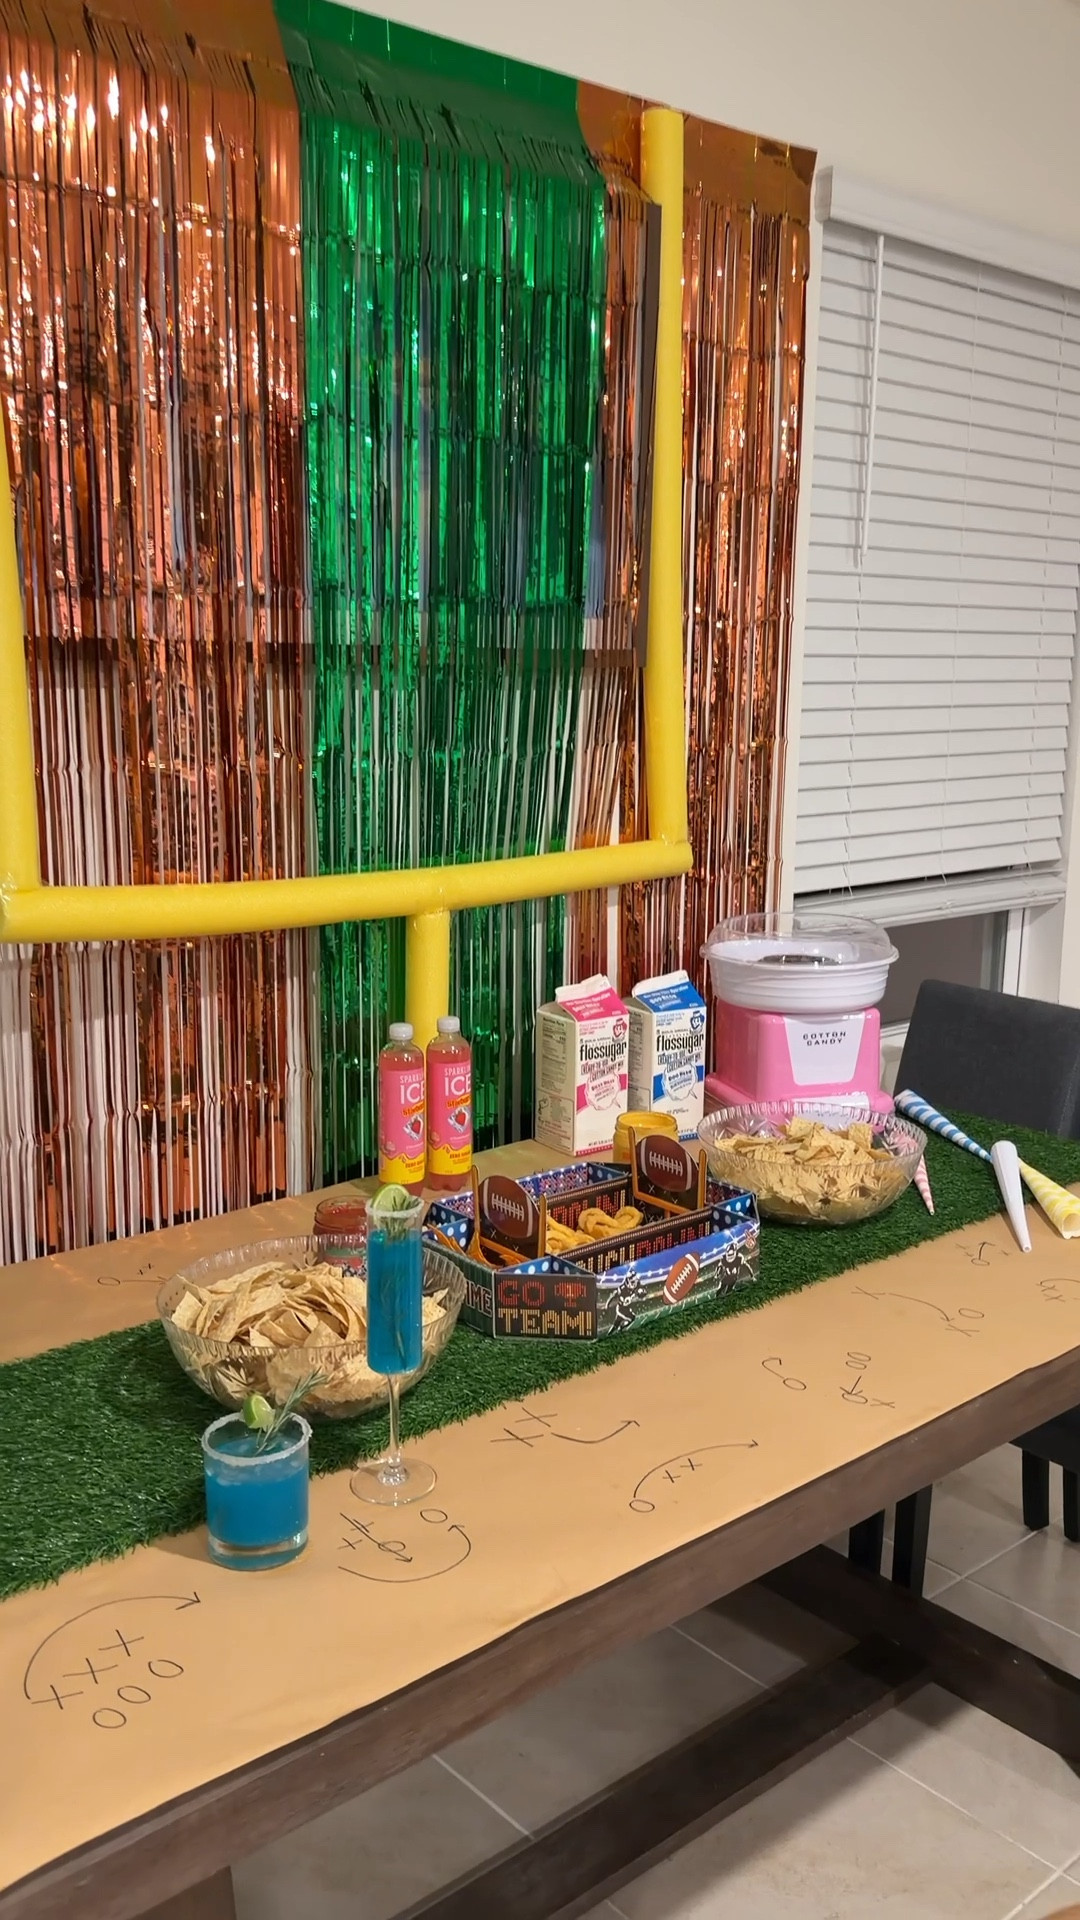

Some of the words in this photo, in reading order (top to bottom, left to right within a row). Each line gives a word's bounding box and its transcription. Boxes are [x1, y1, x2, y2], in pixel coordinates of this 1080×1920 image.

[657, 1033, 704, 1054] flossugar
[803, 1032, 846, 1040] COTTON
[807, 1038, 842, 1046] CANDY
[580, 1041, 627, 1062] flossugar
[444, 1073, 471, 1096] ICE
[466, 1280, 493, 1318] IME
[498, 1280, 545, 1306] GO
[498, 1308, 592, 1336] TEAM!
